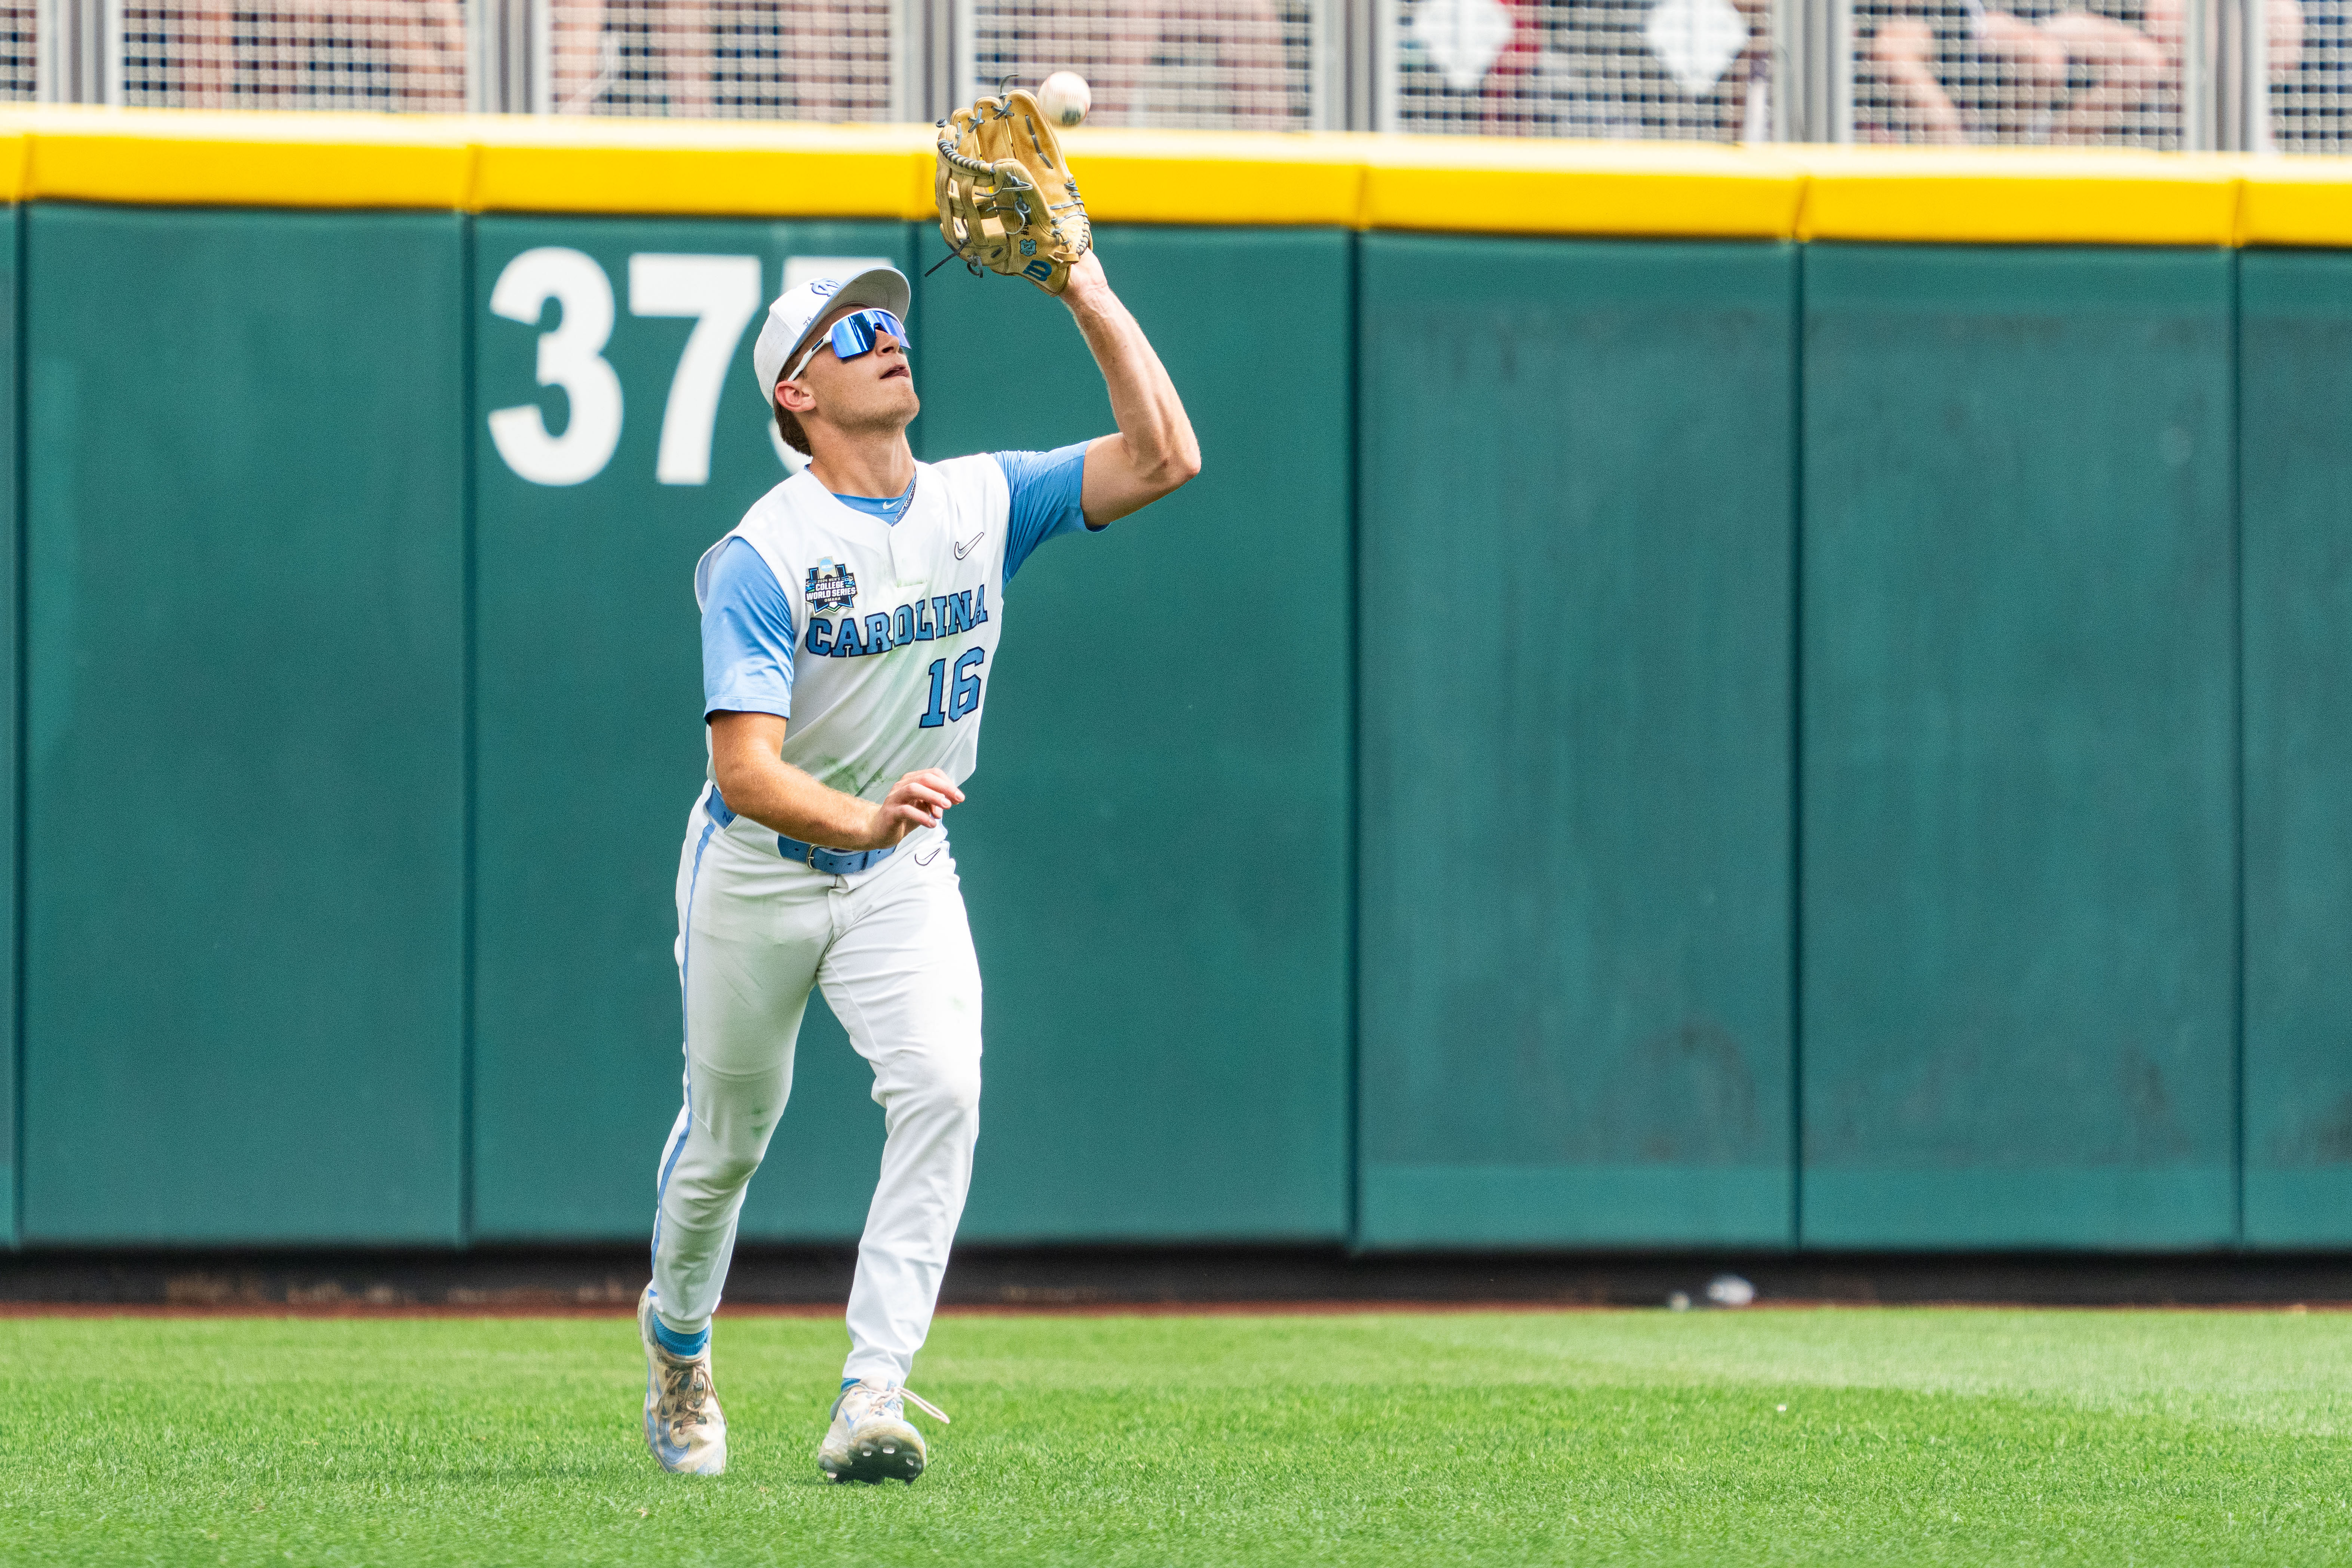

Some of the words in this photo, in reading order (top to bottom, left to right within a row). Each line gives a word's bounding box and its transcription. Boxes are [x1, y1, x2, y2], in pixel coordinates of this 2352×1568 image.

[806, 590, 831, 601] WORLD
[832, 587, 856, 597] SERIES
[816, 581, 844, 591] COLLEGE
[805, 584, 988, 658] CAROLINA
[919, 646, 985, 729] 16
